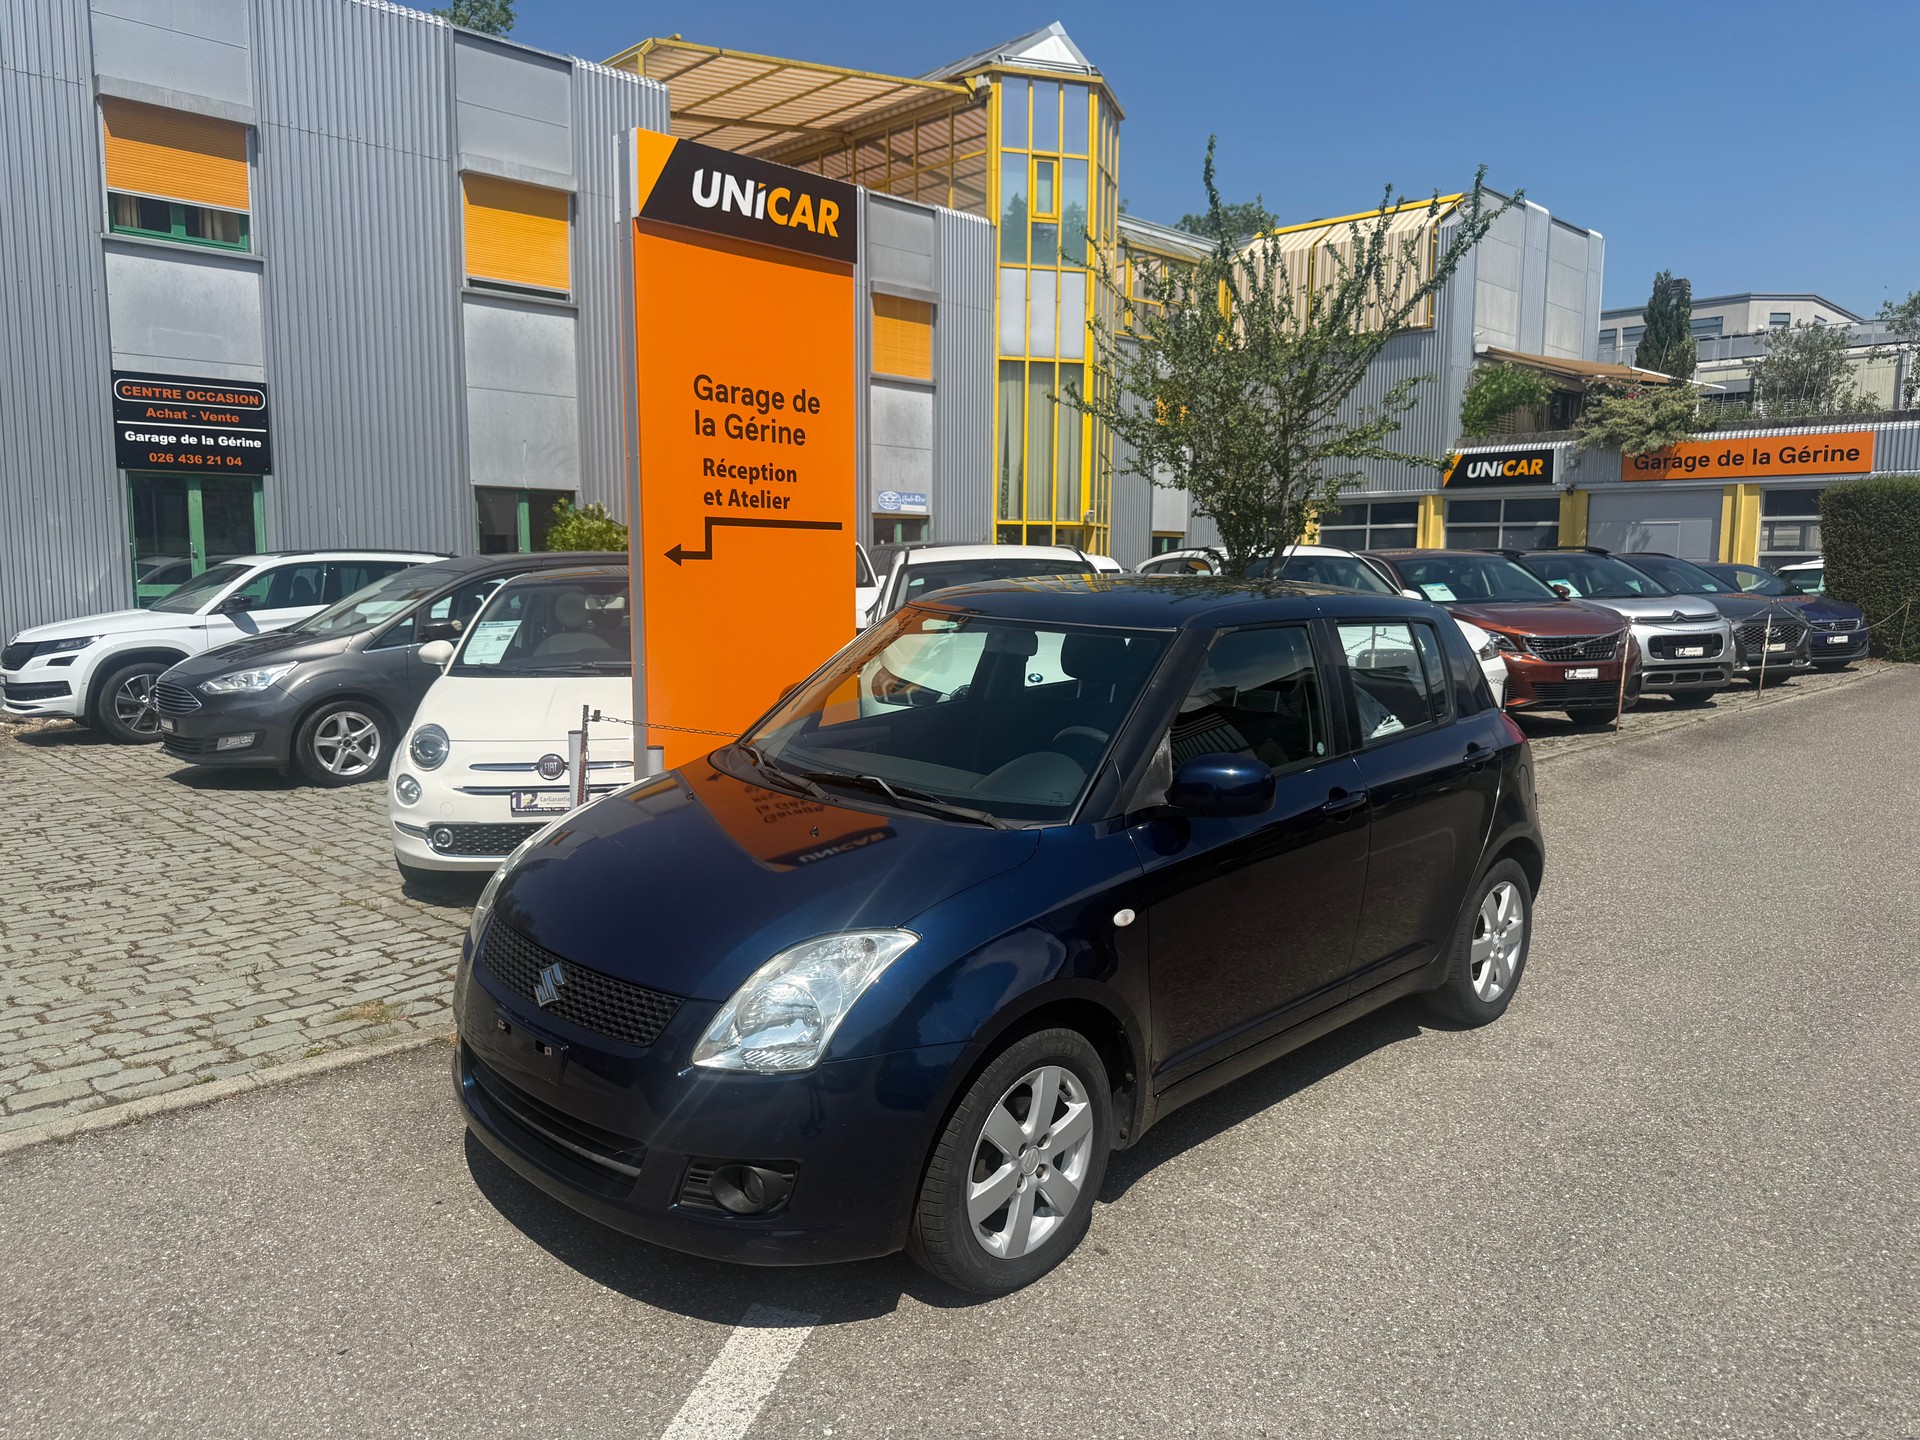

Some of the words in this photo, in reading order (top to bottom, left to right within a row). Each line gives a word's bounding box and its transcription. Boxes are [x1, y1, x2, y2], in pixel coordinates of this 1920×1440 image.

[121, 385, 182, 400] CENTRE
[186, 390, 260, 406] OCCASION
[693, 373, 785, 415] Garage
[792, 388, 821, 415] de
[146, 407, 188, 420] Achat
[200, 411, 240, 423] Vente
[694, 409, 716, 437] la
[724, 413, 806, 446] Gérine
[124, 430, 177, 446] Garage
[180, 434, 198, 445] de
[201, 435, 215, 446] la
[218, 435, 262, 448] Gérine
[148, 452, 175, 463] 026
[178, 454, 203, 465] 436
[206, 455, 222, 465] 21
[226, 456, 243, 466] 04
[1633, 450, 1711, 472] Garage
[1717, 449, 1745, 467] de
[1752, 448, 1771, 466] la
[1778, 444, 1861, 465] Gérine
[702, 457, 798, 485] Réception
[703, 488, 723, 507] et
[727, 488, 791, 510] Atelier
[544, 762, 558, 773] FIAT
